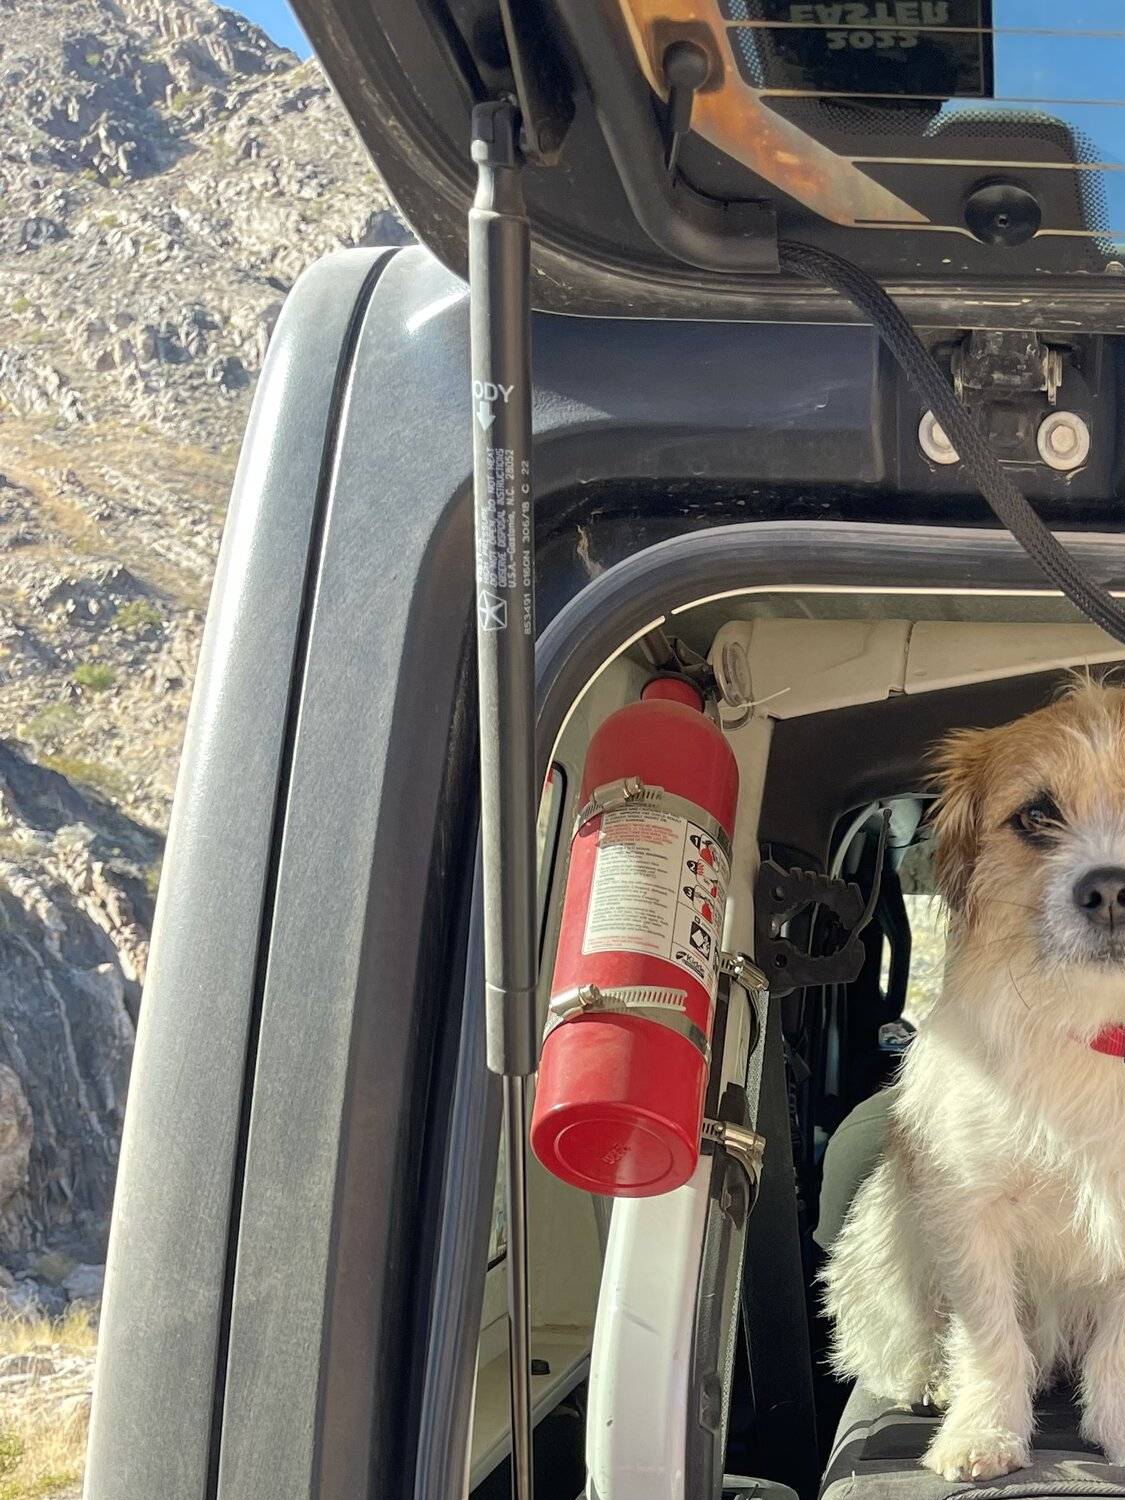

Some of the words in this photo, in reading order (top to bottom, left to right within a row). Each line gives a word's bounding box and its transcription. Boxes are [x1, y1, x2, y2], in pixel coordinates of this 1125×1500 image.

[473, 380, 514, 403] ODY
[505, 449, 514, 480] 28052
[521, 460, 530, 475] 22
[521, 484, 530, 494] C
